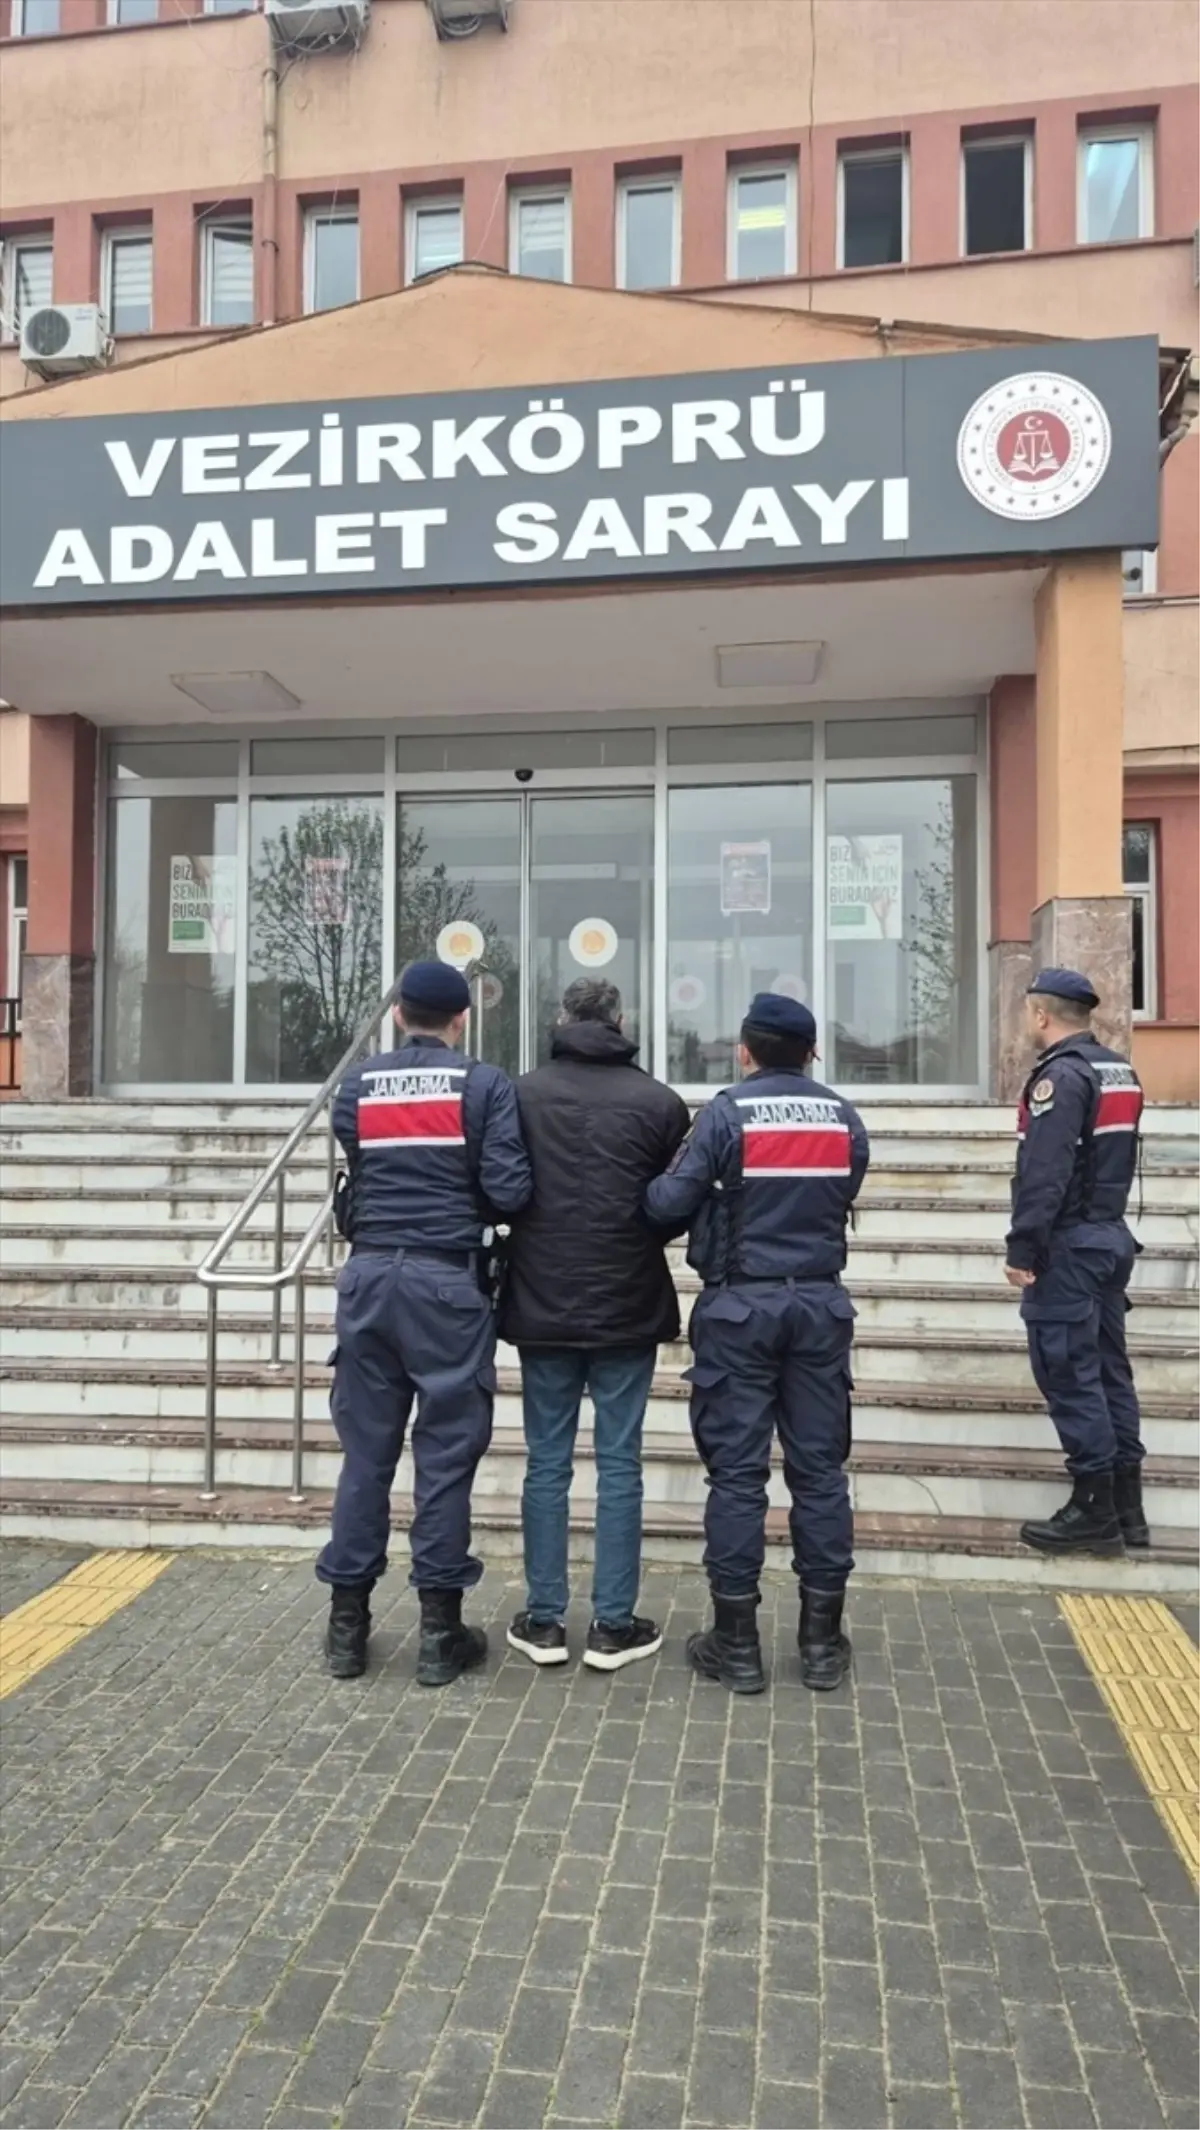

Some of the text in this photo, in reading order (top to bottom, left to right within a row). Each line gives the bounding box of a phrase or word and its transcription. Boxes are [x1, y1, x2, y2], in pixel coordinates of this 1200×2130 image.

[105, 379, 826, 498] VEZİRKÖPRÜ
[33, 477, 910, 588] ADALET SARAYI
[368, 1075, 452, 1097] JANDARMA
[750, 1103, 840, 1123] JANDARMA
